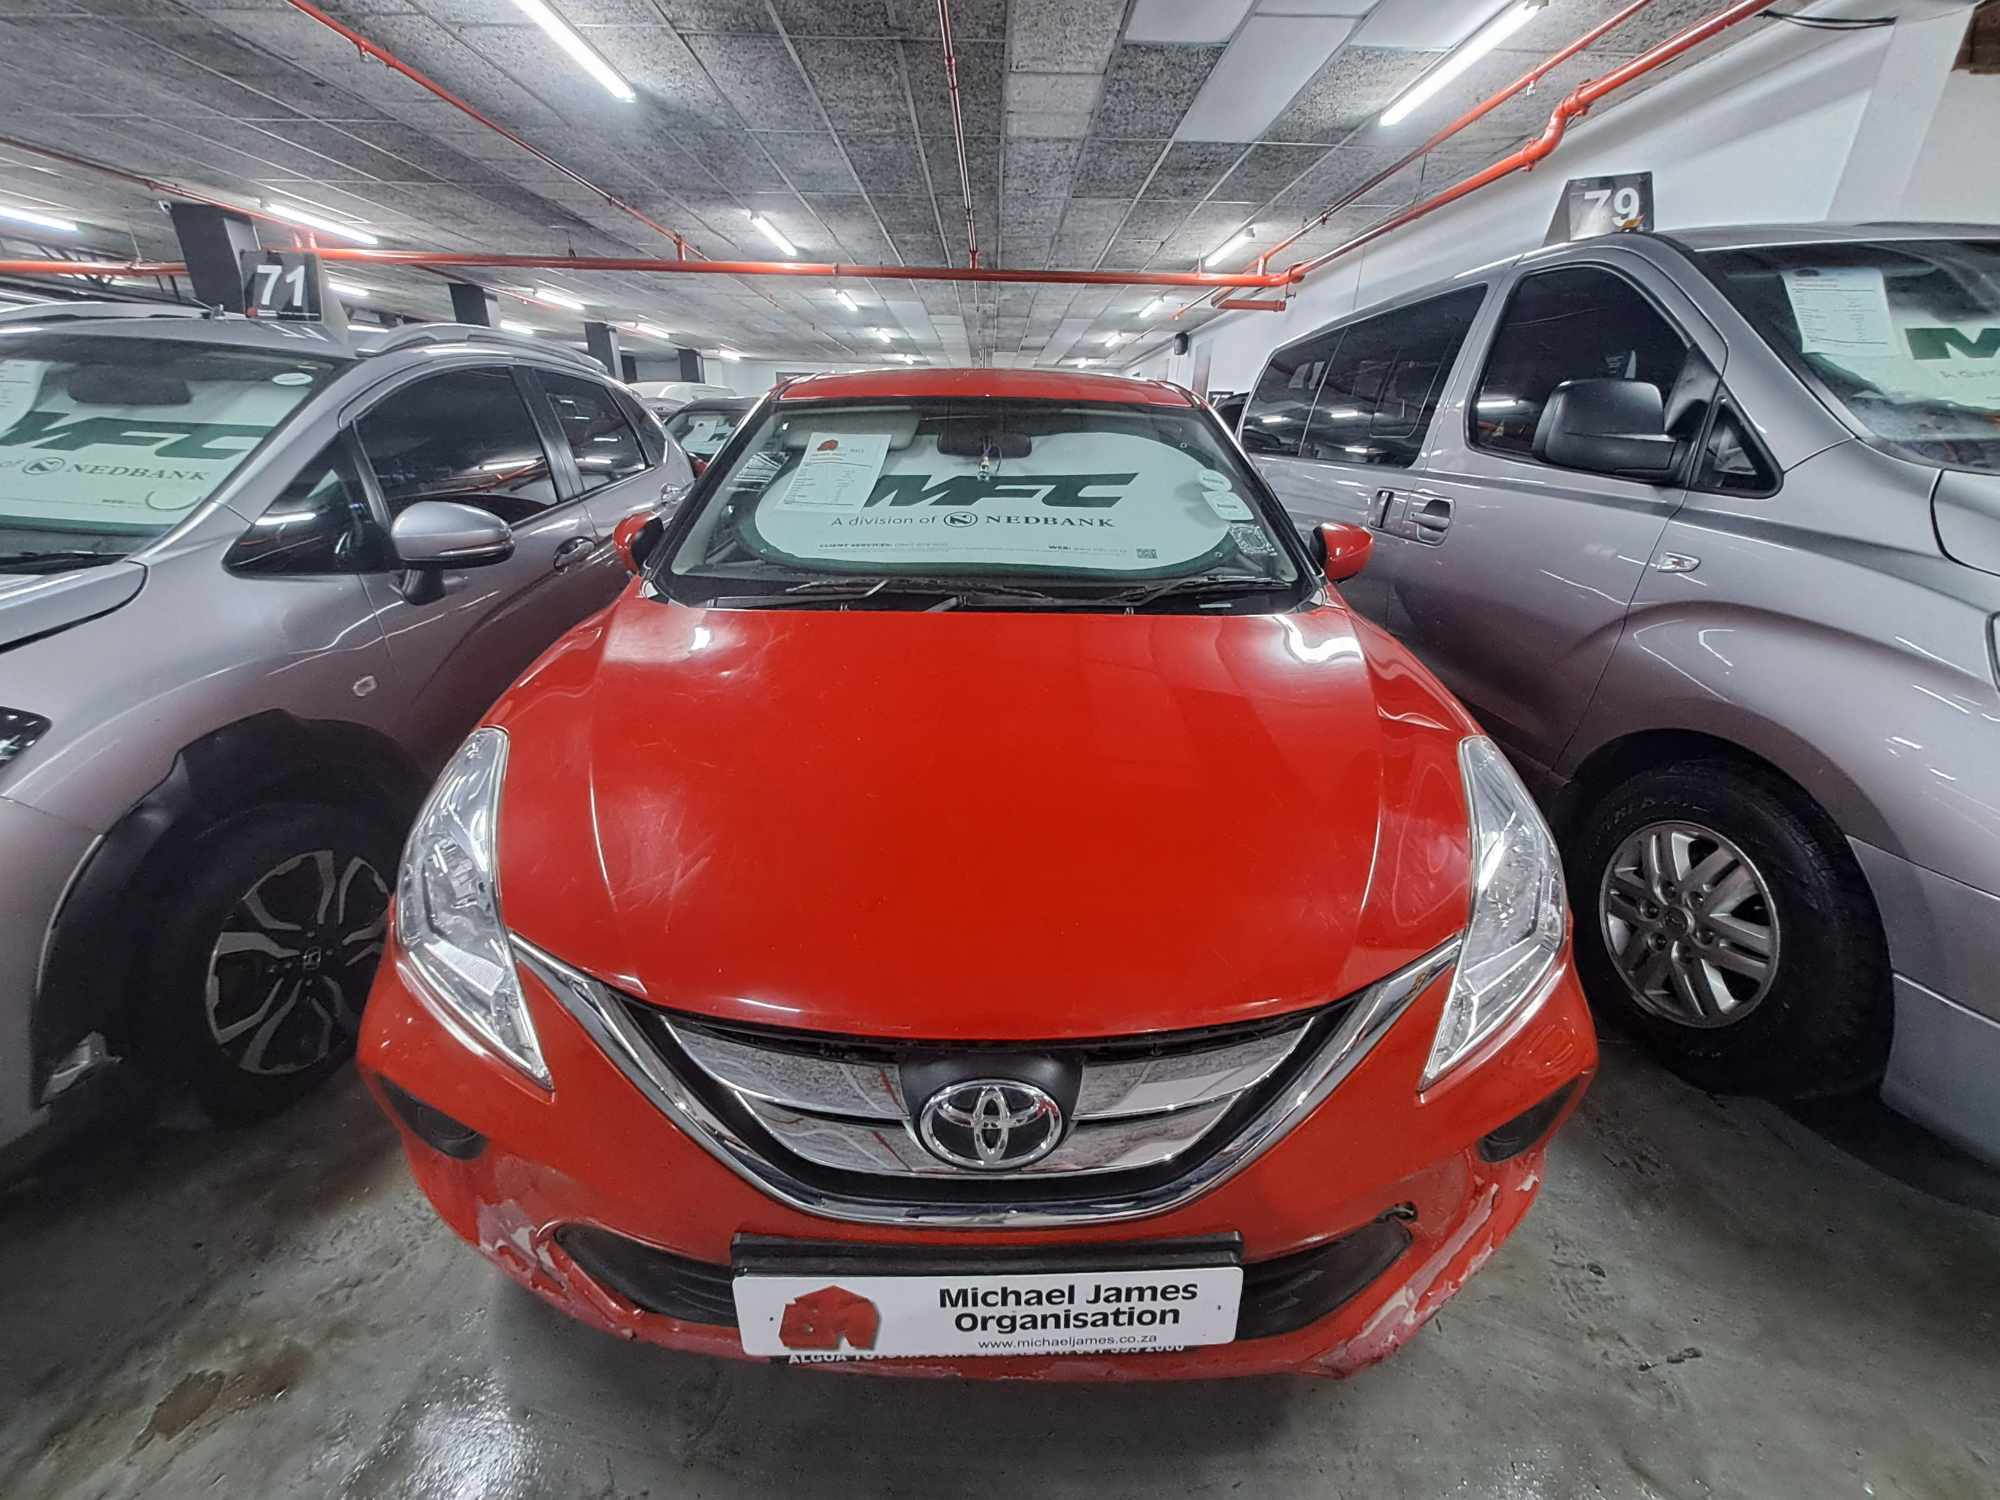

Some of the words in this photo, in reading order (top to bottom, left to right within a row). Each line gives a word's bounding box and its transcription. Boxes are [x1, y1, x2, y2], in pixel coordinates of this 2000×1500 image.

[1584, 187, 1640, 228] 79
[256, 264, 305, 307] 71
[66, 463, 210, 481] NEDBANK
[862, 472, 1140, 508] MFC
[830, 517, 842, 526] A
[848, 515, 913, 527] division
[919, 516, 936, 525] of
[985, 515, 1116, 528] NEDBANK
[939, 1284, 1076, 1309] Michael
[1085, 1283, 1199, 1305] James
[954, 1306, 1181, 1335] Organisation
[977, 1334, 1158, 1350] www.michaeljames.co.za
